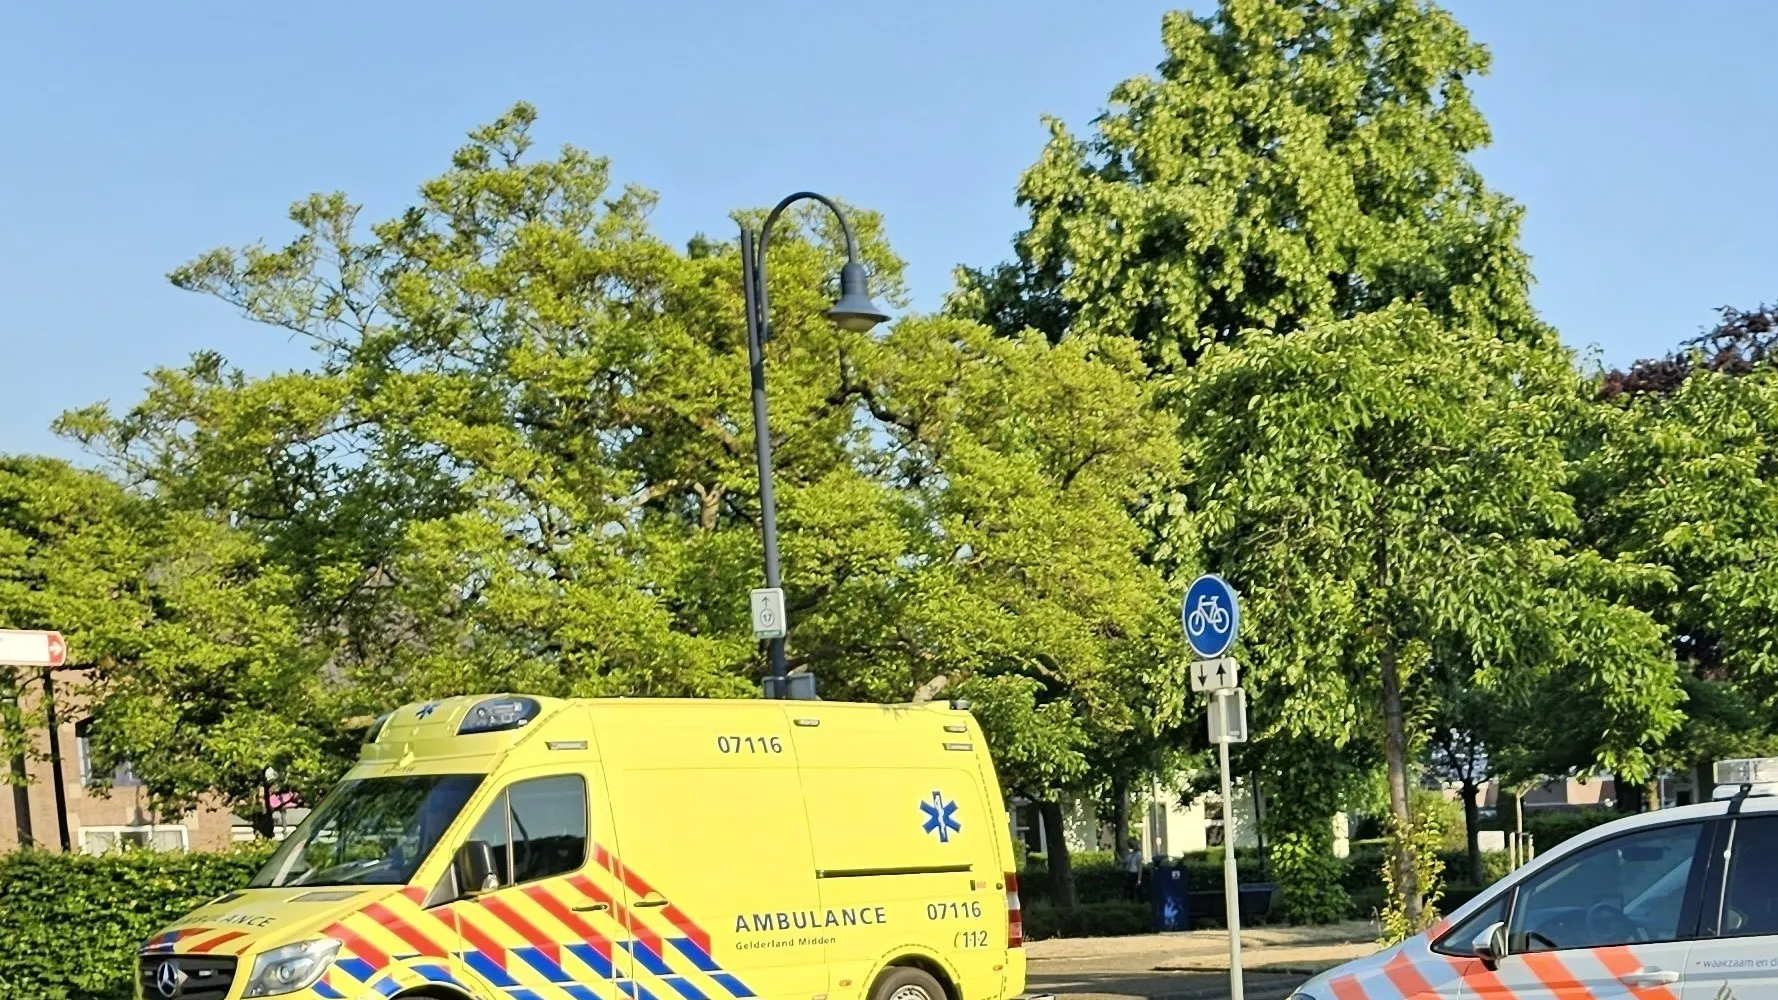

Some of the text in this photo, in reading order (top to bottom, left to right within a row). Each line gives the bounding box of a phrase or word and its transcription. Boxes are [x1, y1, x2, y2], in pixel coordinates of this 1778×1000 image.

[762, 613, 772, 622] 17
[718, 736, 782, 753] 07116
[735, 901, 981, 933] AMBULANCE 07116
[736, 936, 836, 951] Gelderland Midden
[1703, 959, 1754, 968] waakzaam
